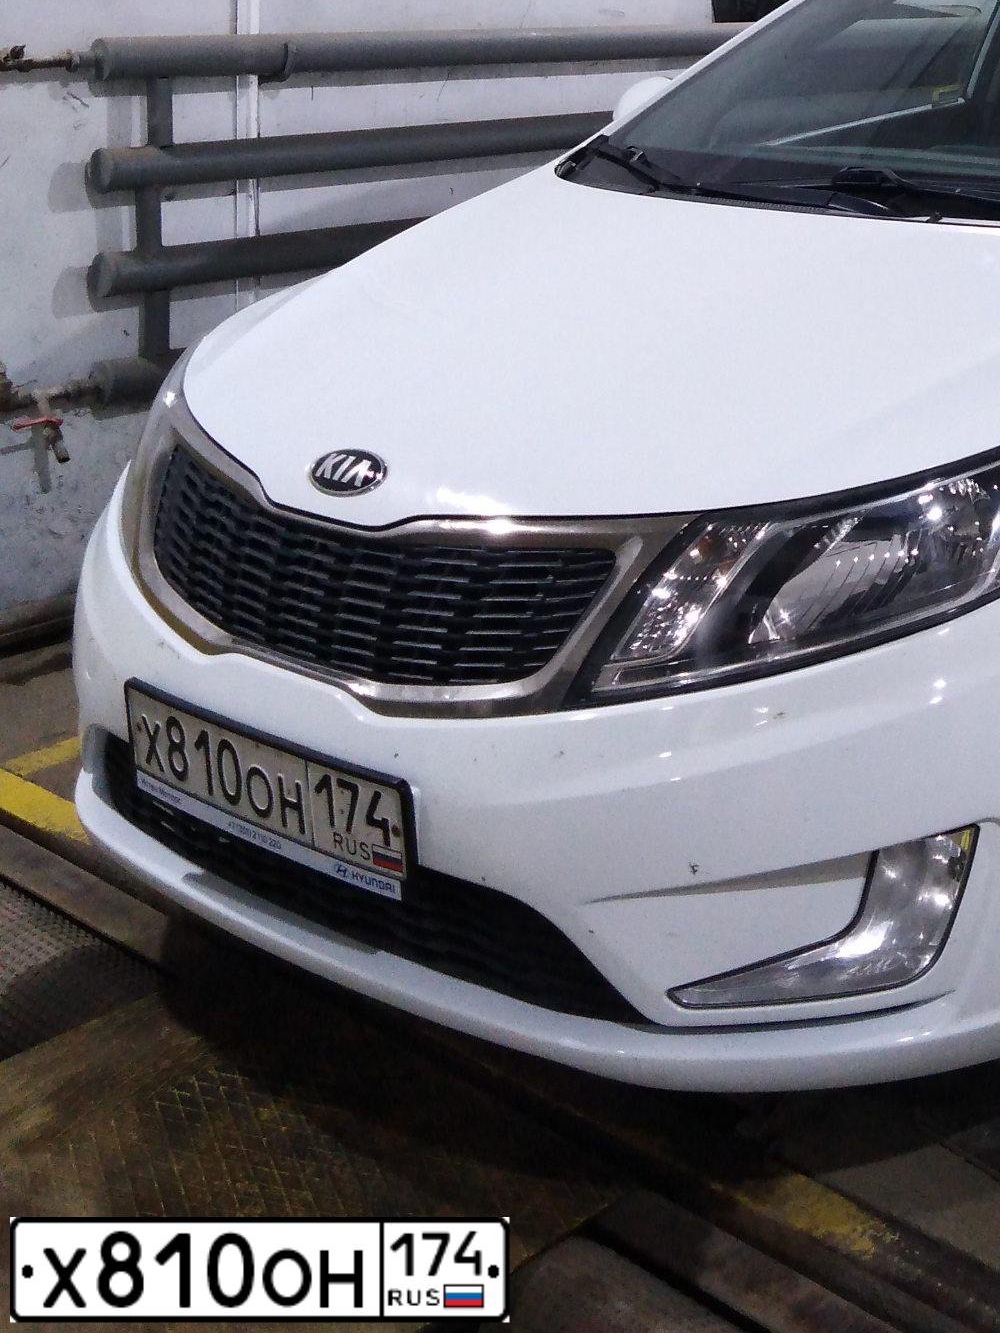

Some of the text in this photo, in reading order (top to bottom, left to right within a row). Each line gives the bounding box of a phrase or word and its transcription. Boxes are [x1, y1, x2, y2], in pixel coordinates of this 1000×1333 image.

[315, 453, 372, 487] KIA
[142, 715, 305, 835] Х810ОН
[314, 773, 390, 847] 174
[332, 832, 371, 860] RUS
[351, 870, 396, 894] HYUNDAI
